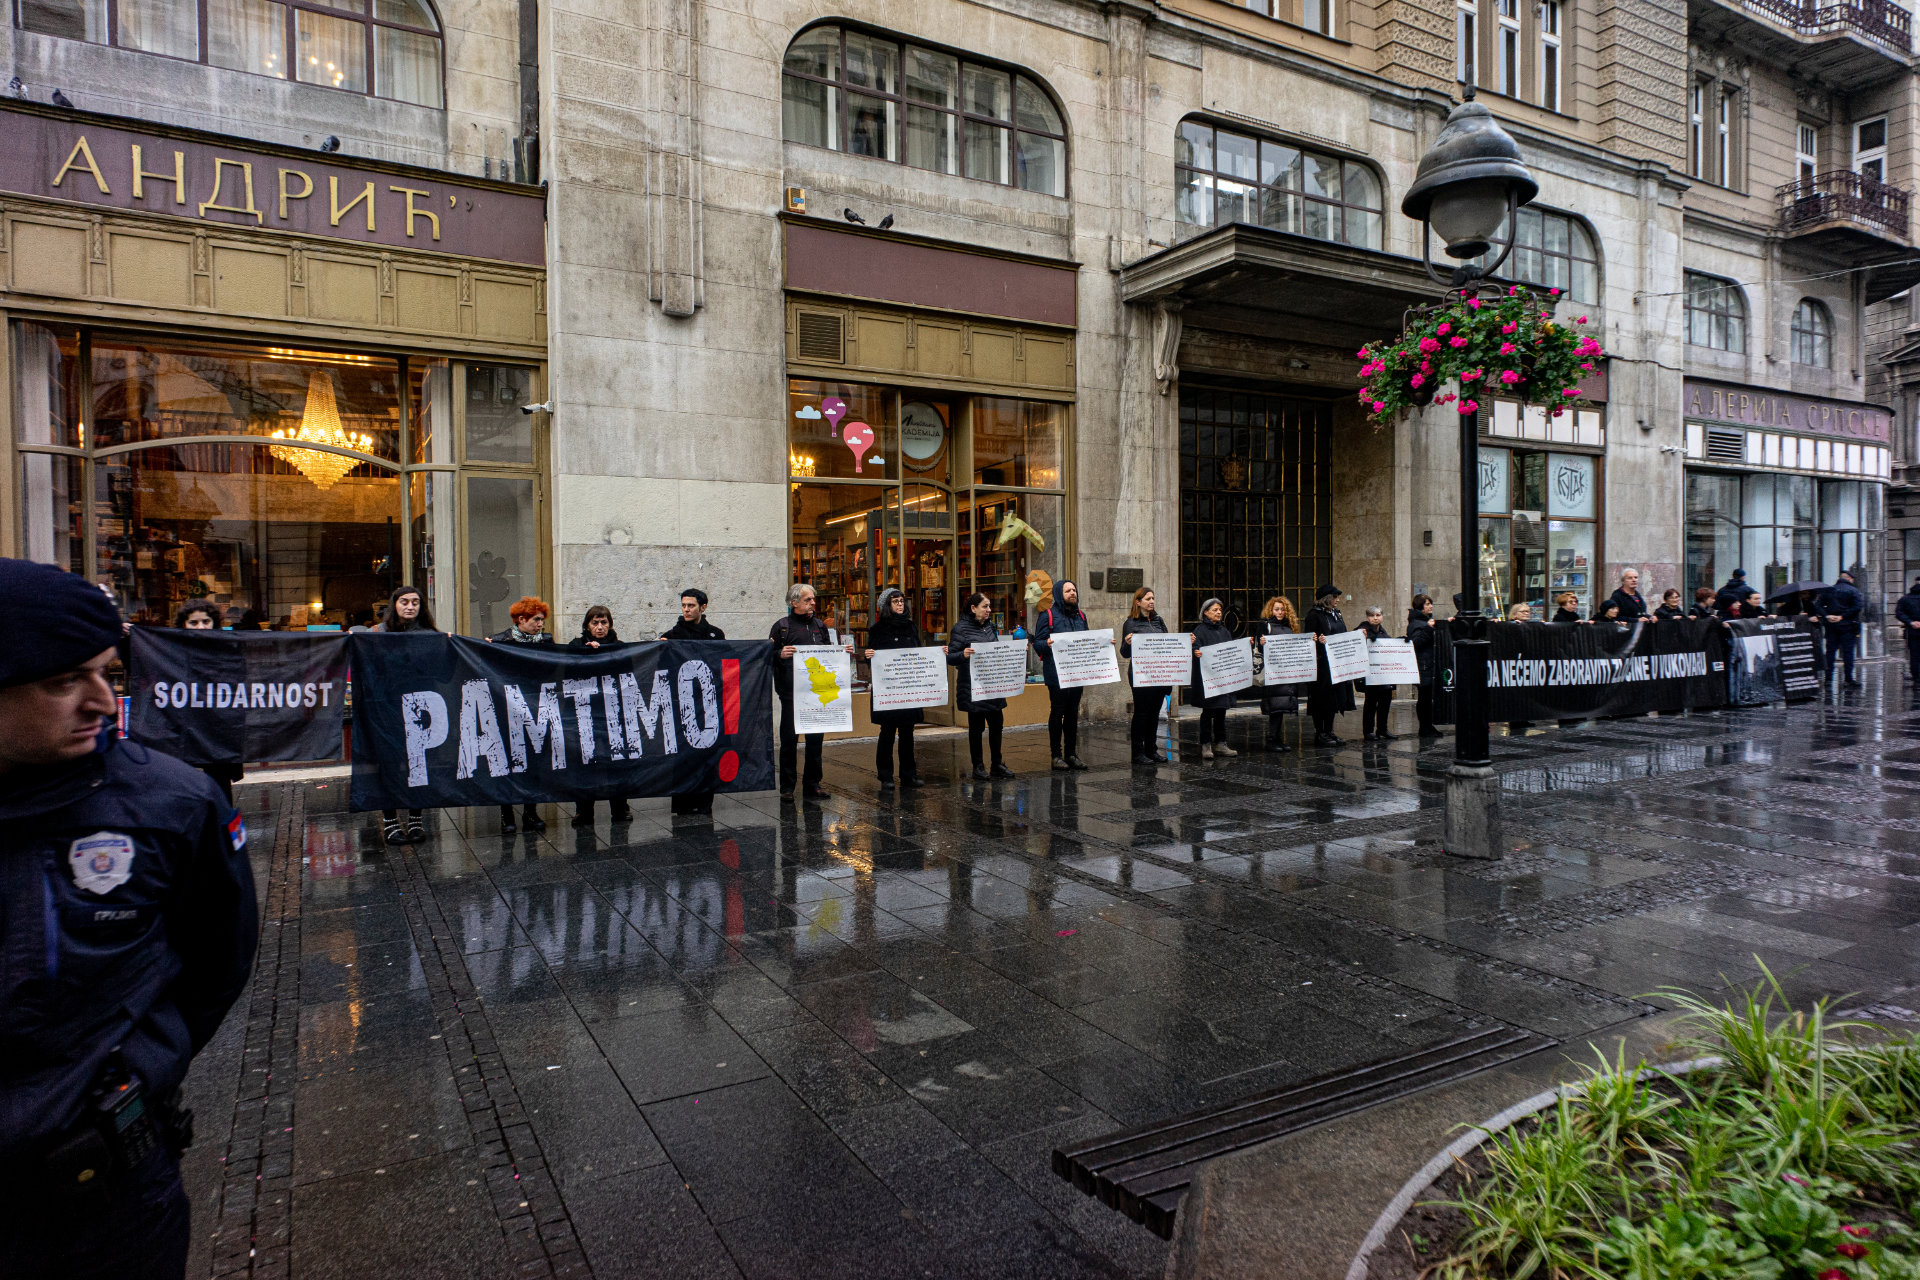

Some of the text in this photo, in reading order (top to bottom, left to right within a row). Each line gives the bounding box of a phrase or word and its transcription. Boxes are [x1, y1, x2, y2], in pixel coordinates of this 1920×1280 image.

[1689, 390, 1881, 437] АЛЕРИЈА СРПСКЕ
[902, 428, 940, 437] KADEMIJA
[1501, 652, 1546, 688] NEĆEMO
[1548, 658, 1611, 686] ZABORAVITI
[1650, 654, 1659, 680] U
[1659, 651, 1707, 679] VUKOVARU
[154, 681, 333, 709] SOLIDARNOST
[402, 658, 740, 787] PAMTIMO!
